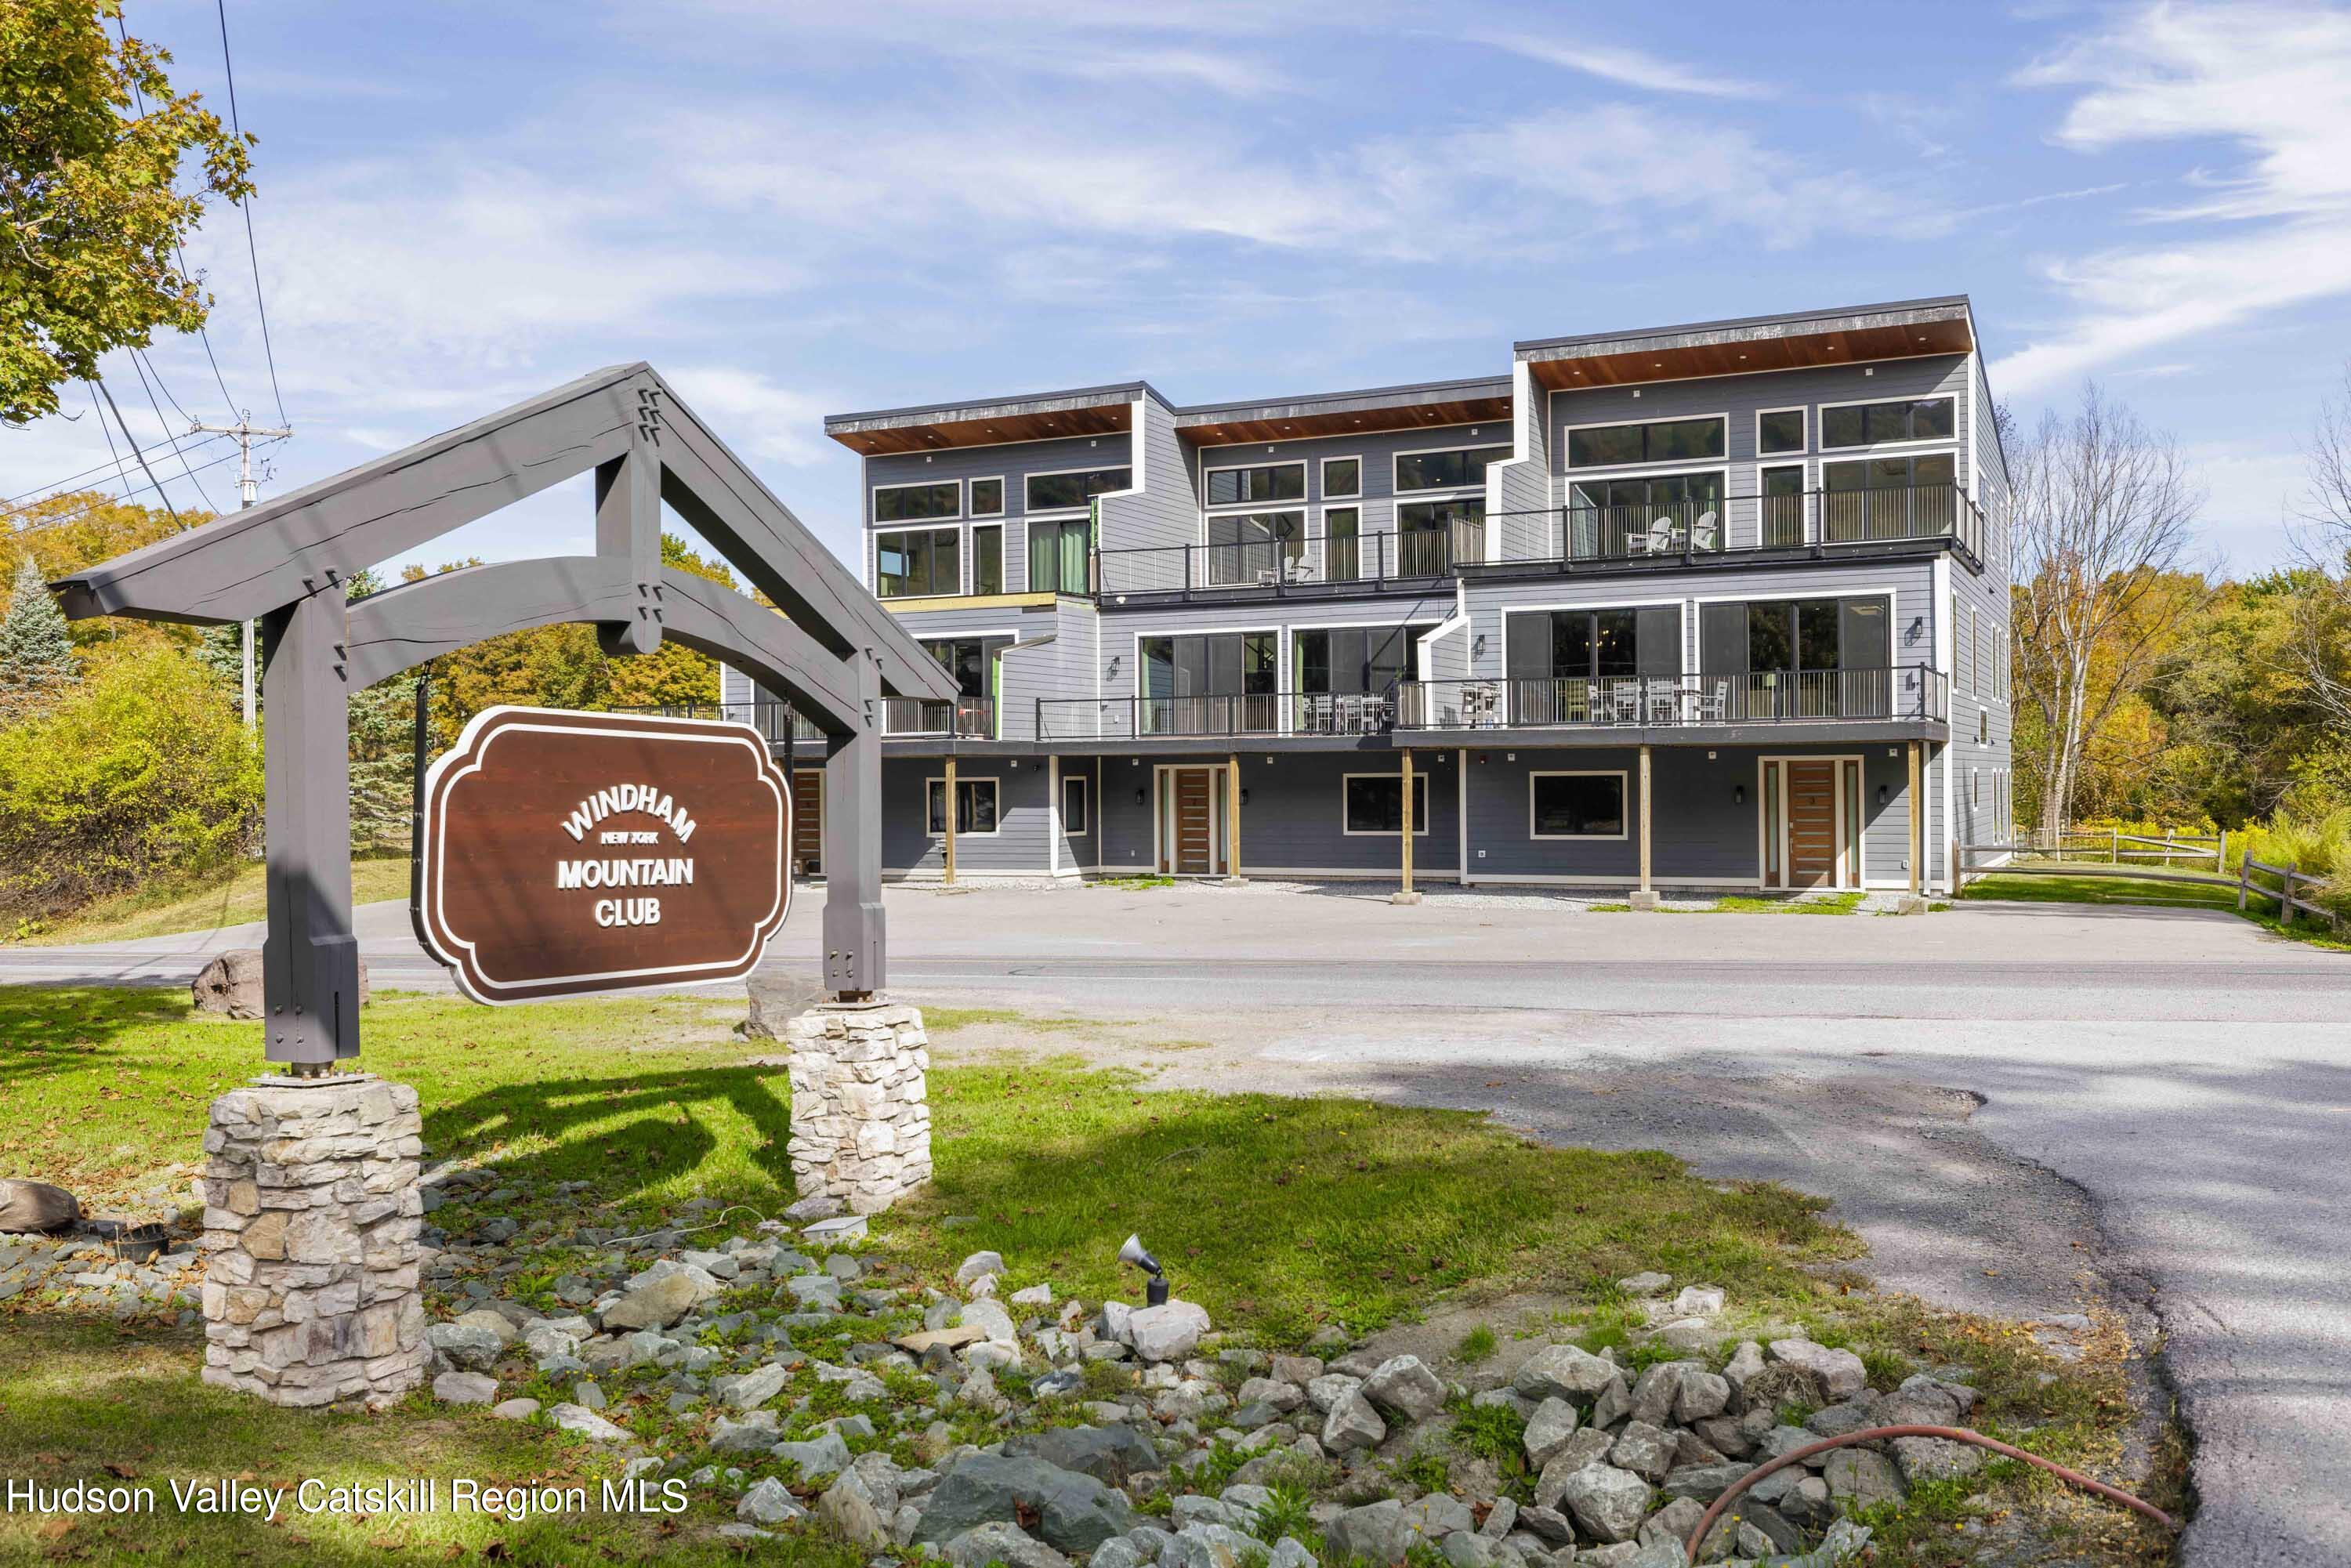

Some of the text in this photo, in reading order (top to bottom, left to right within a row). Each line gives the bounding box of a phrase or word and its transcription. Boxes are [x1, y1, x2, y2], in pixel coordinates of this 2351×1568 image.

[560, 783, 697, 843] WINDHAM
[601, 831, 659, 844] NEW YORK
[557, 858, 694, 889] MOUNTAIN
[595, 897, 661, 927] CLUB
